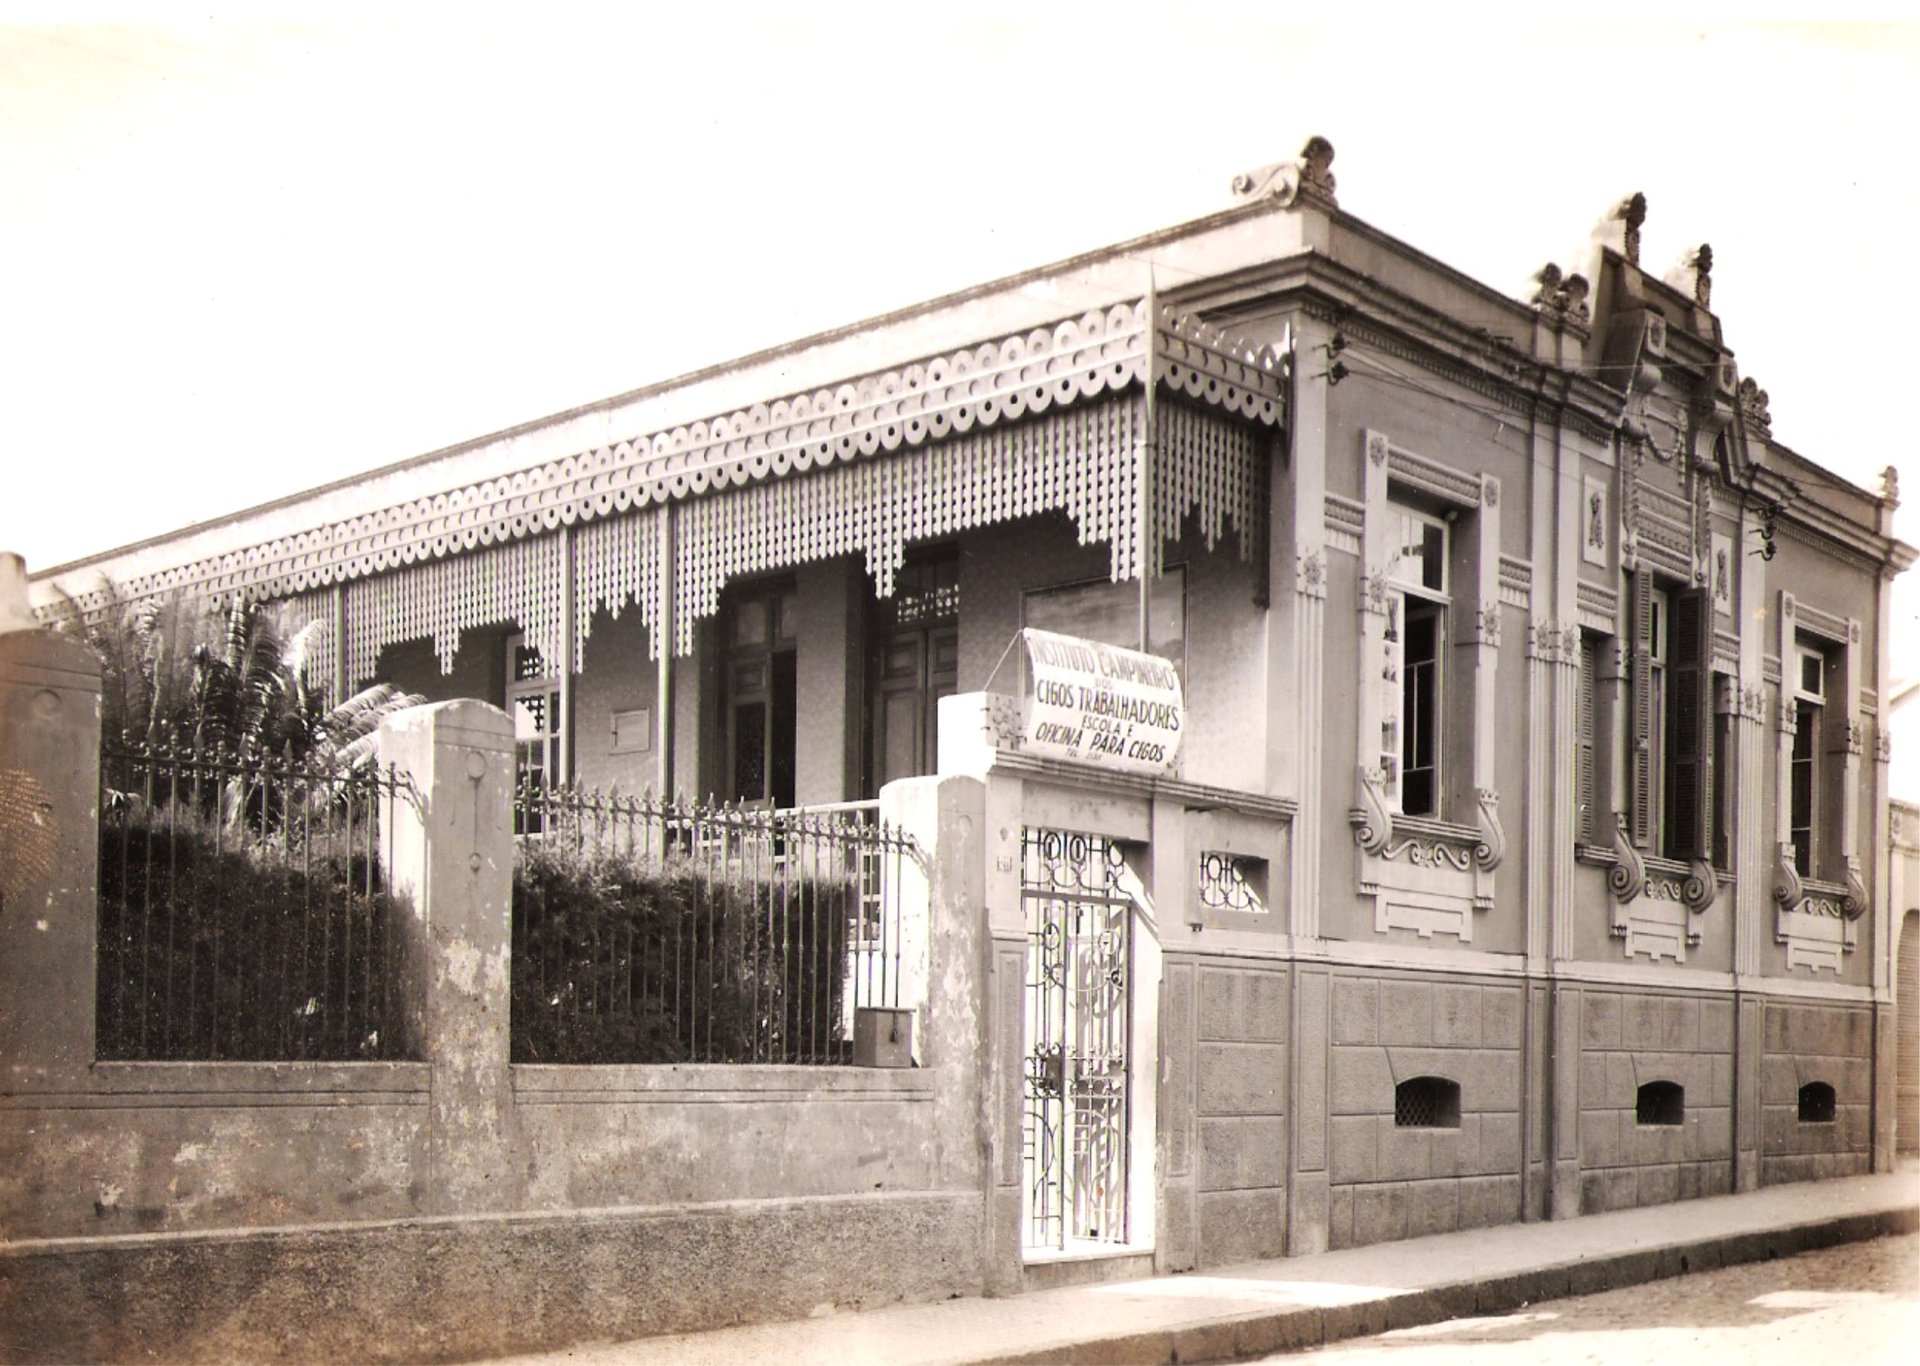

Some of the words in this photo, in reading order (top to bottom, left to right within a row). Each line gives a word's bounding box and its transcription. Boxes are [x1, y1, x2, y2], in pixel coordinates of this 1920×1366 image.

[1031, 639, 1096, 675] INSTITUTO
[1079, 687, 1180, 732] TRABALHADORES
[1082, 715, 1121, 734] ESCOLA
[1127, 724, 1134, 737] E
[1036, 722, 1083, 748] OFICINA
[1090, 733, 1126, 757] PARA
